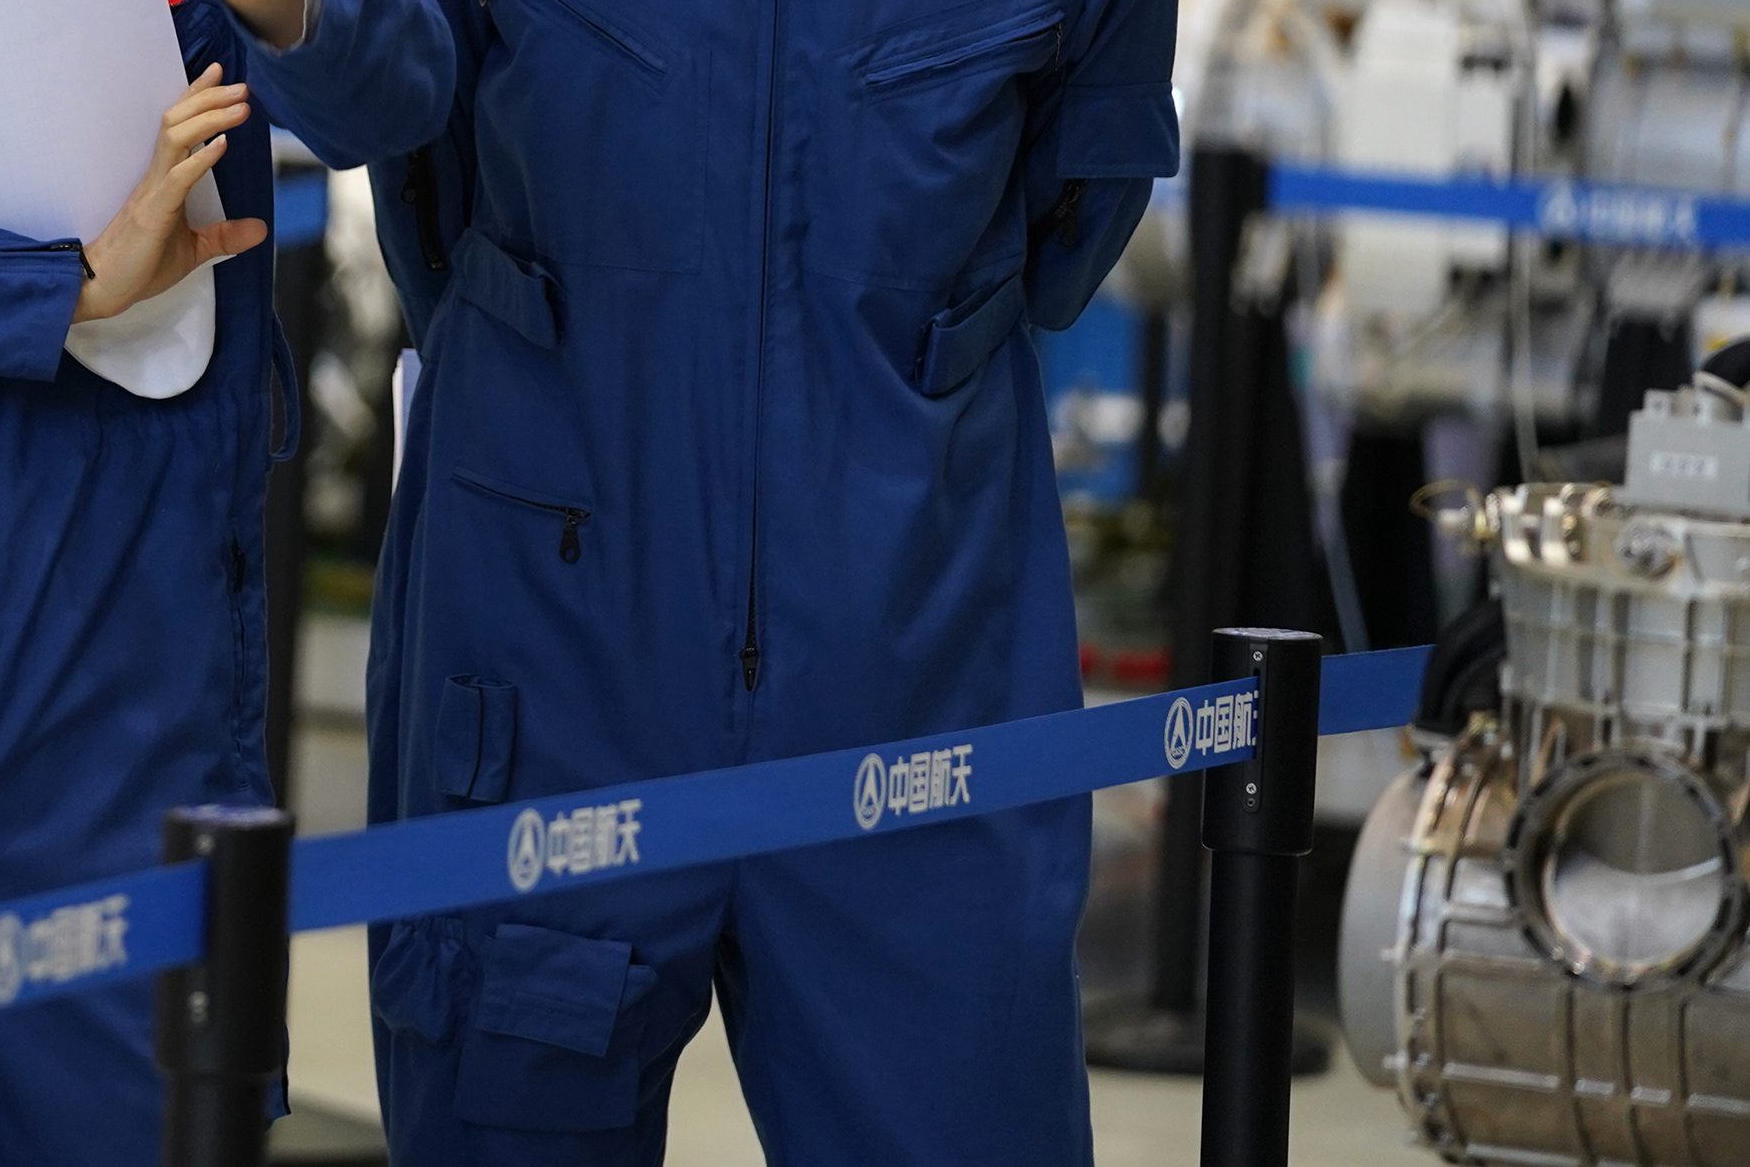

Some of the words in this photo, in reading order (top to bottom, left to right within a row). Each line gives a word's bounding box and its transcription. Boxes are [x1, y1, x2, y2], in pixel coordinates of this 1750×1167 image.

[888, 744, 973, 816] 中国航天
[546, 797, 643, 875] 中国航天
